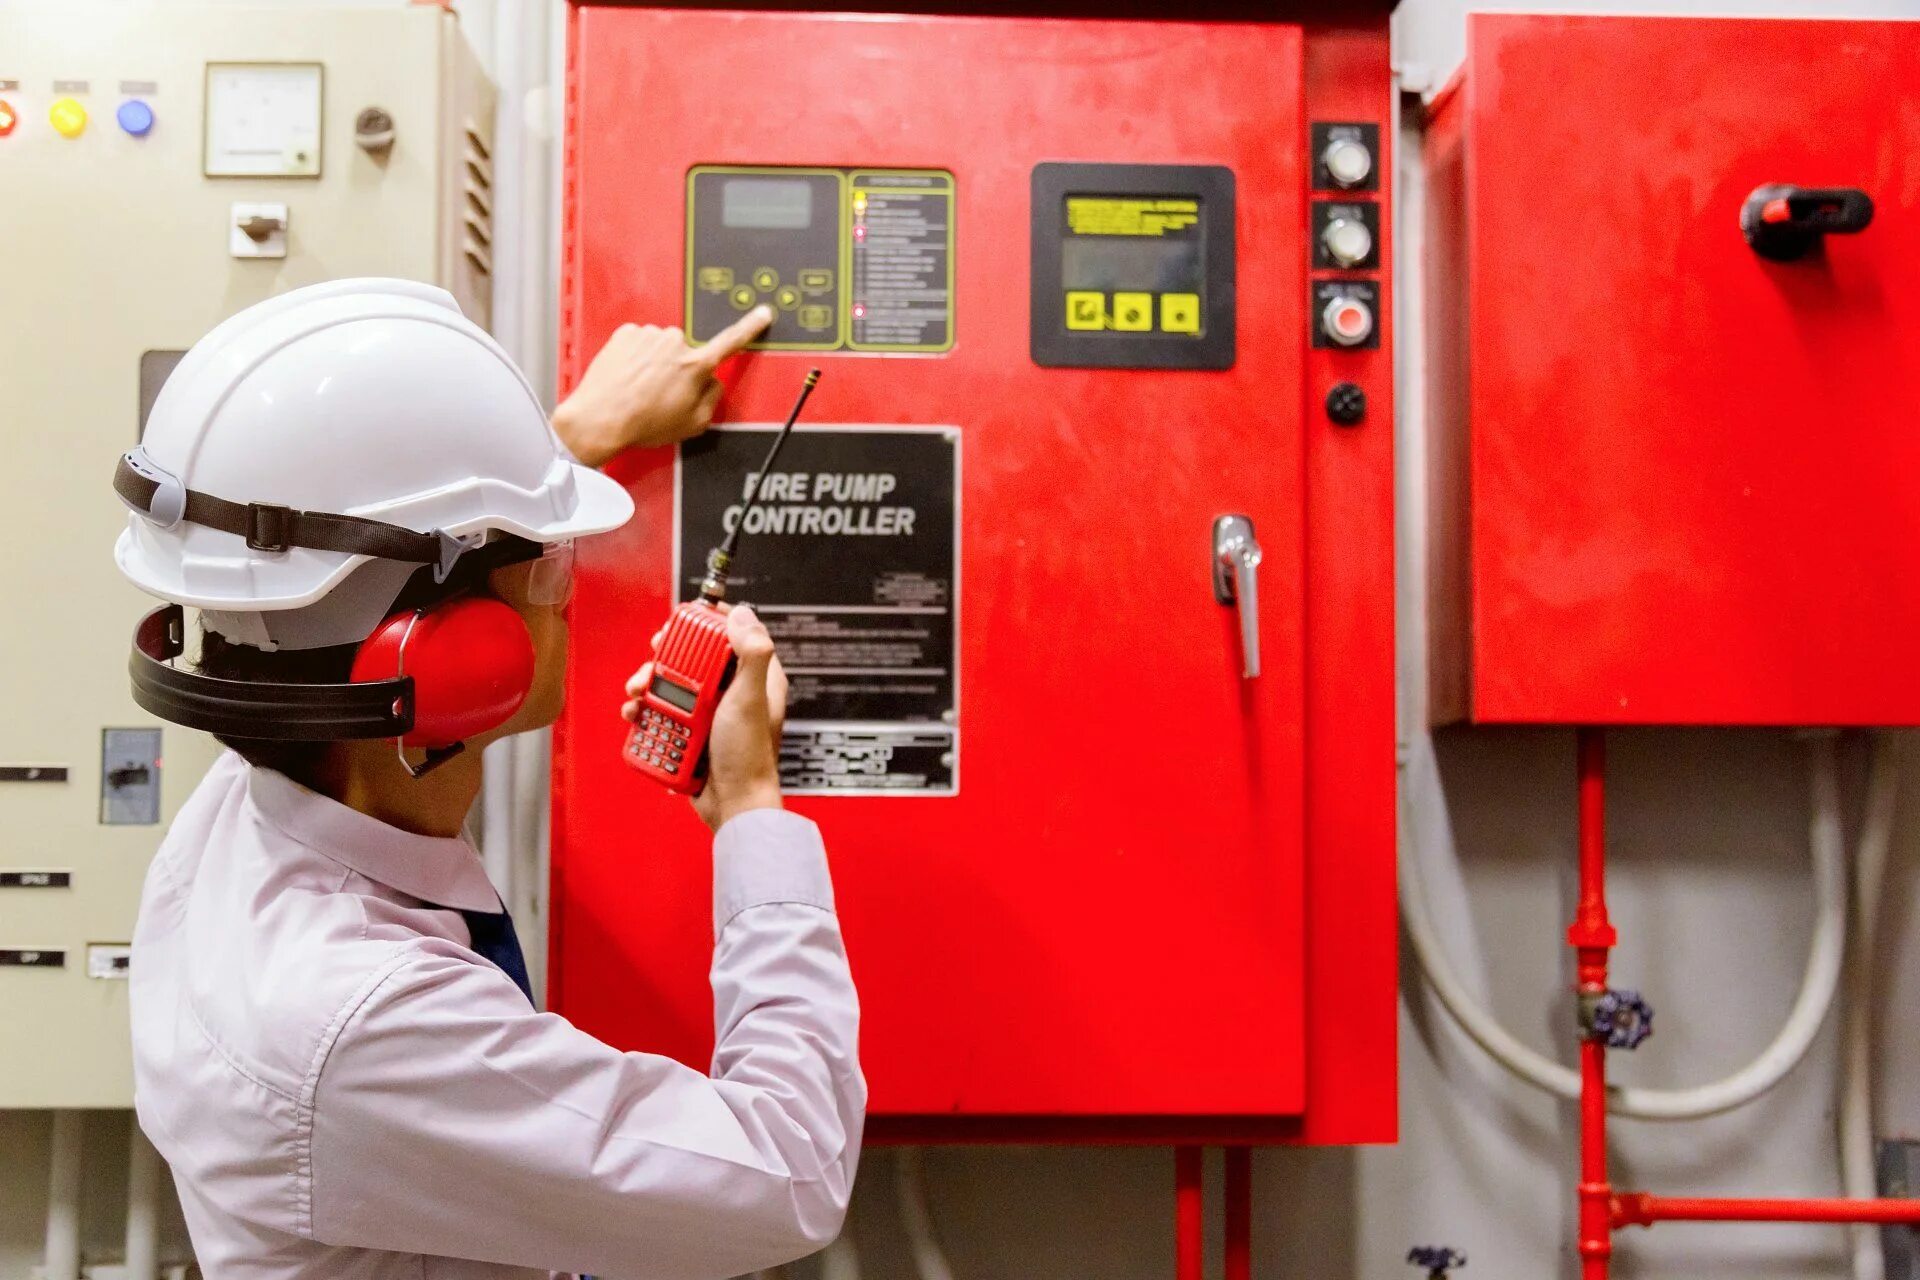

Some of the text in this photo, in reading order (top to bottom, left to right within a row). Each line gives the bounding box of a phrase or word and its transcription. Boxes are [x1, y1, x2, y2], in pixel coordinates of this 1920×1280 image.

[743, 472, 896, 502] FIRE PUMP
[722, 505, 916, 535] CONTROLLER
